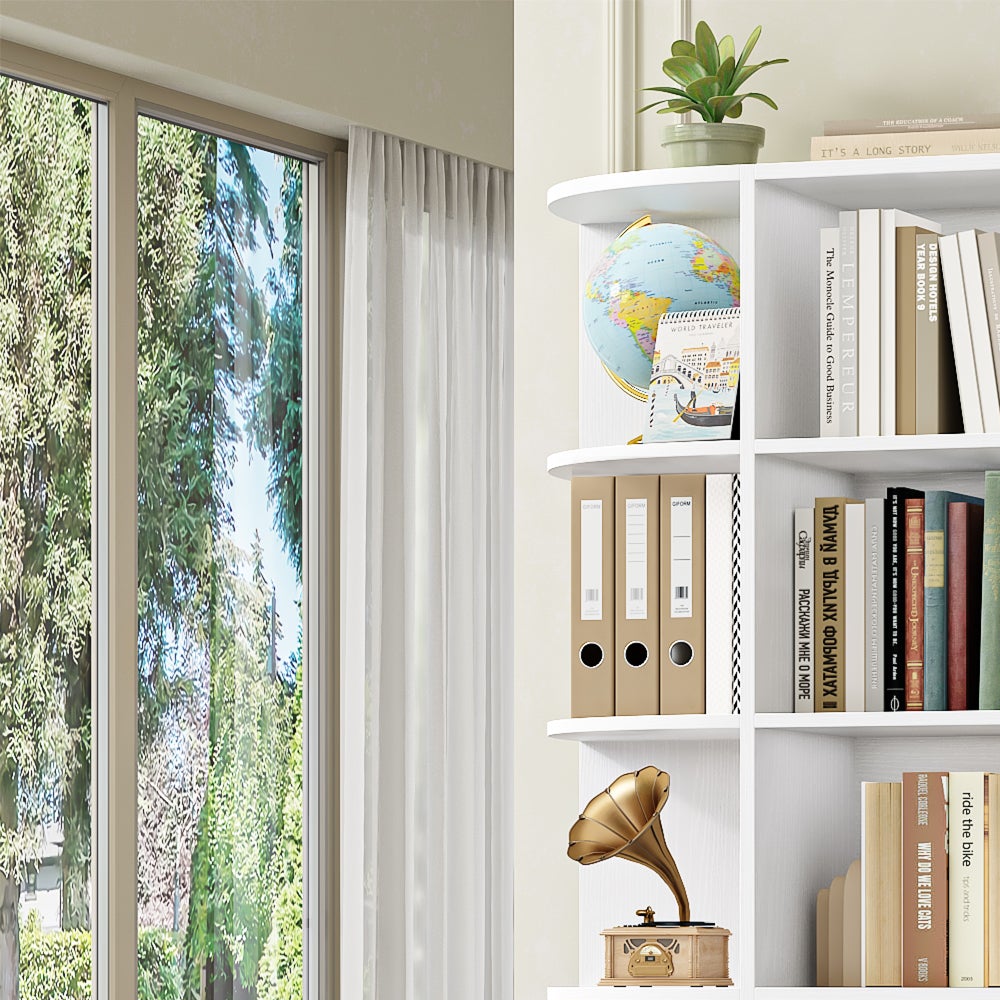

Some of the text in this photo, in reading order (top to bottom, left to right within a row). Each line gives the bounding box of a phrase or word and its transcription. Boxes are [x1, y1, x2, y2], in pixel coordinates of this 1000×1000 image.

[821, 144, 932, 158] IT'S A LONG STORY
[917, 243, 926, 311] YEAR BOOK 9
[928, 243, 938, 322] DESIGN HOTELS
[699, 321, 733, 329] TRAVELER
[826, 248, 835, 424] The Monocle Guide to Good Business
[841, 263, 855, 414] LEMPEREUR
[798, 589, 811, 639] РАССКАЖИ
[798, 642, 811, 662] МНЕ
[798, 674, 811, 700] МОРЕ
[962, 791, 973, 867] ride the bike
[917, 842, 932, 930] WHY DO WE LOVE CATS
[960, 876, 971, 922] tips and tricks
